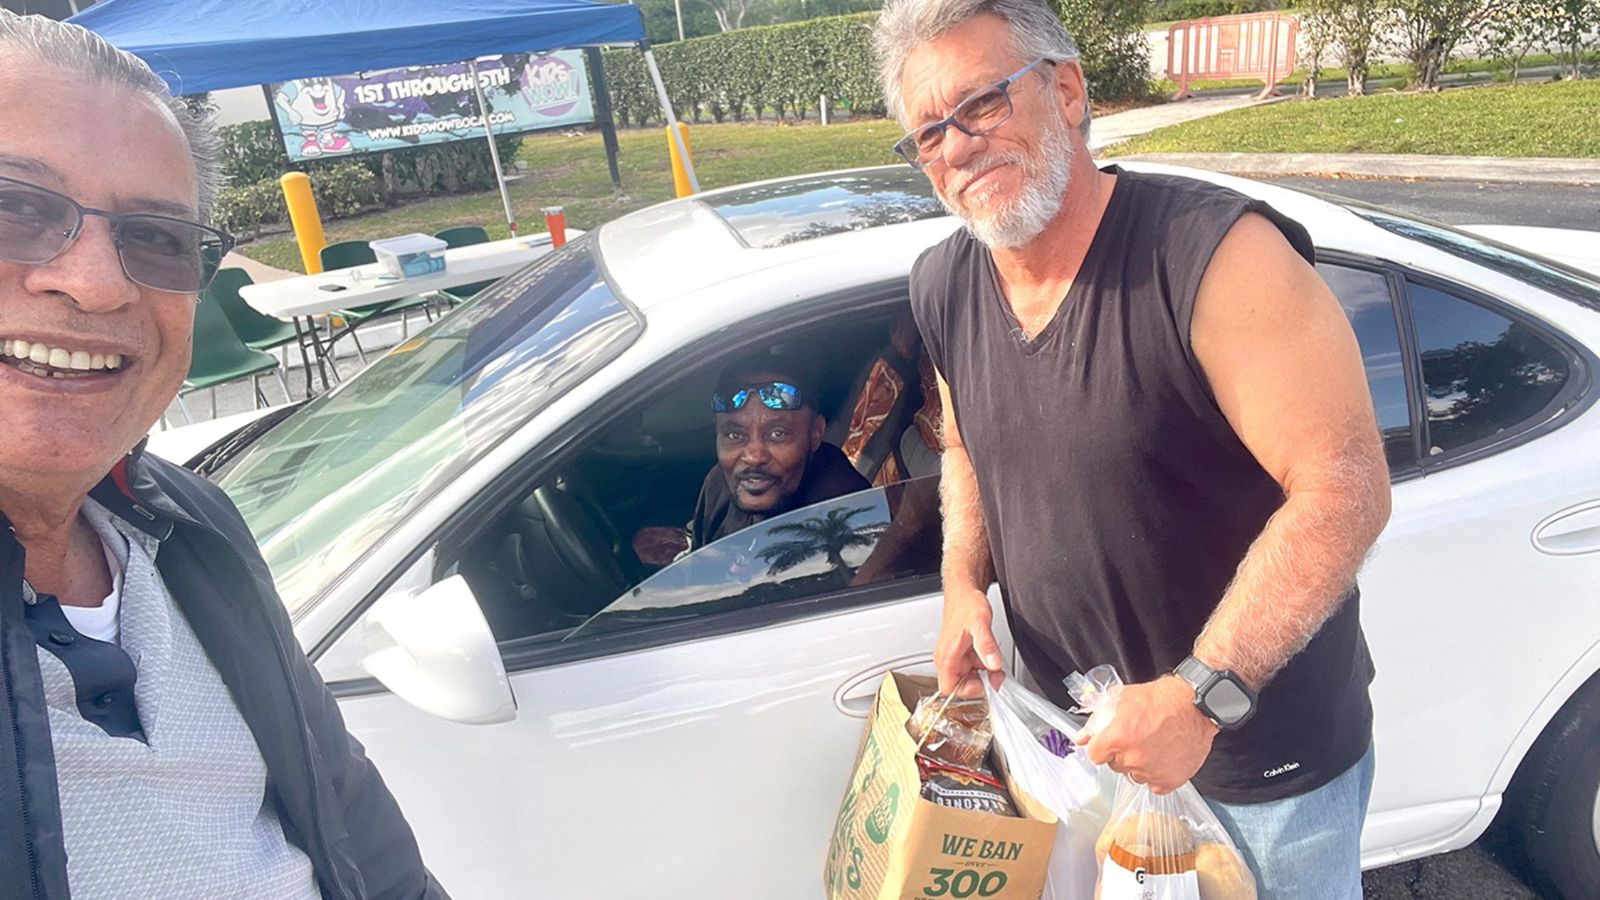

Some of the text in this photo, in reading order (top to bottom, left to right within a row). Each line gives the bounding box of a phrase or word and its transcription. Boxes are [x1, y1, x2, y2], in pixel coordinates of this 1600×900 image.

[354, 67, 511, 103] 1ST THROUGH 5TH
[368, 112, 515, 140] WWW.KIDSWOWBOCACOM
[941, 833, 1024, 860] WE BAN
[964, 861, 987, 869] over
[923, 867, 1008, 898] 300
